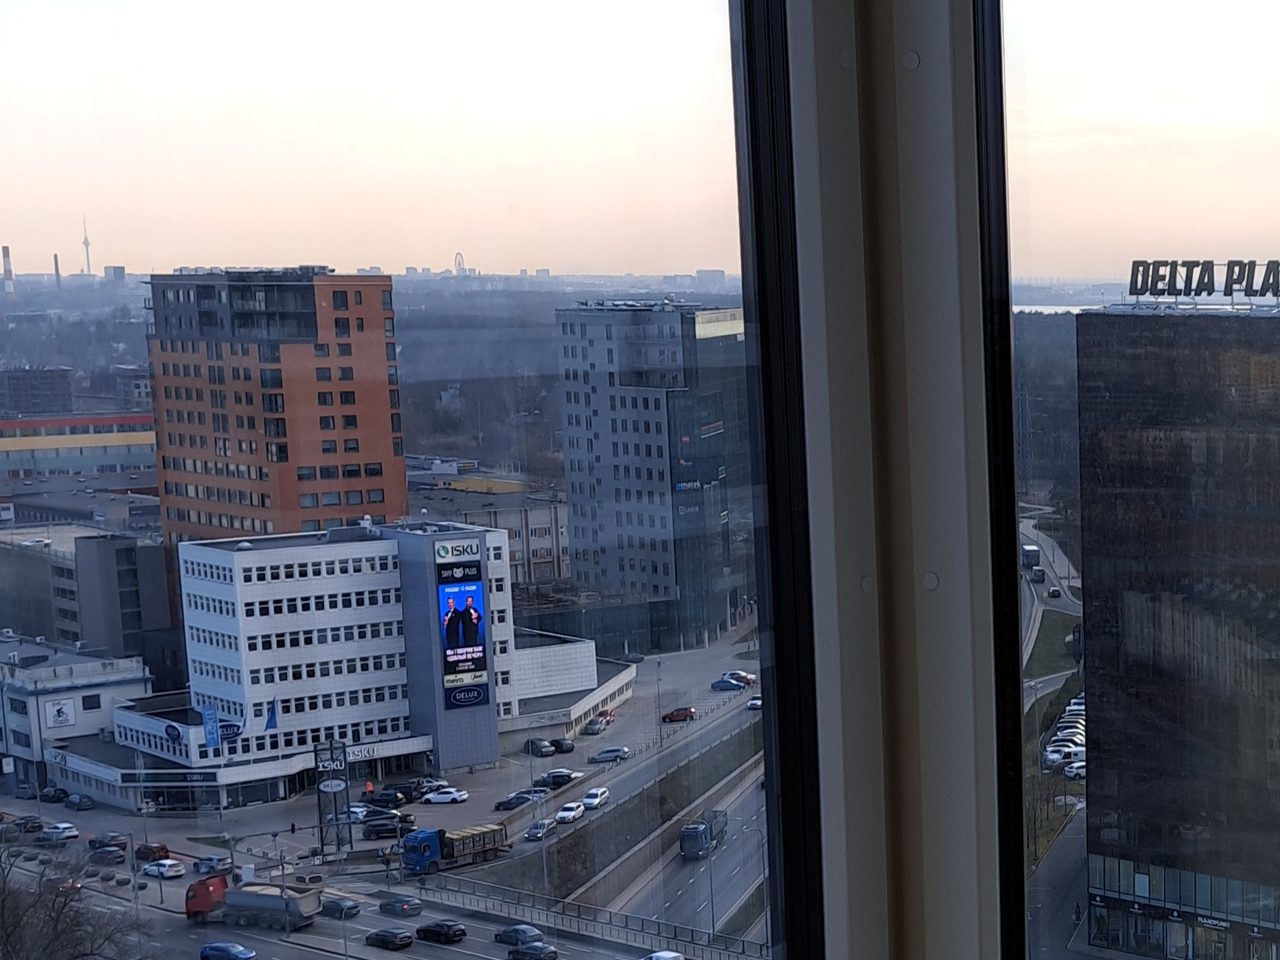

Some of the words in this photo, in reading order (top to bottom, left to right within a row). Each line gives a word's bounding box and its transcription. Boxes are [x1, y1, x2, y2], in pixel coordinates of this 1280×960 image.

[1129, 260, 1214, 296] DELTA
[451, 544, 479, 557] ISKU
[456, 691, 478, 699] DELUX
[348, 746, 377, 760] ISKU
[317, 761, 345, 771] ISKU
